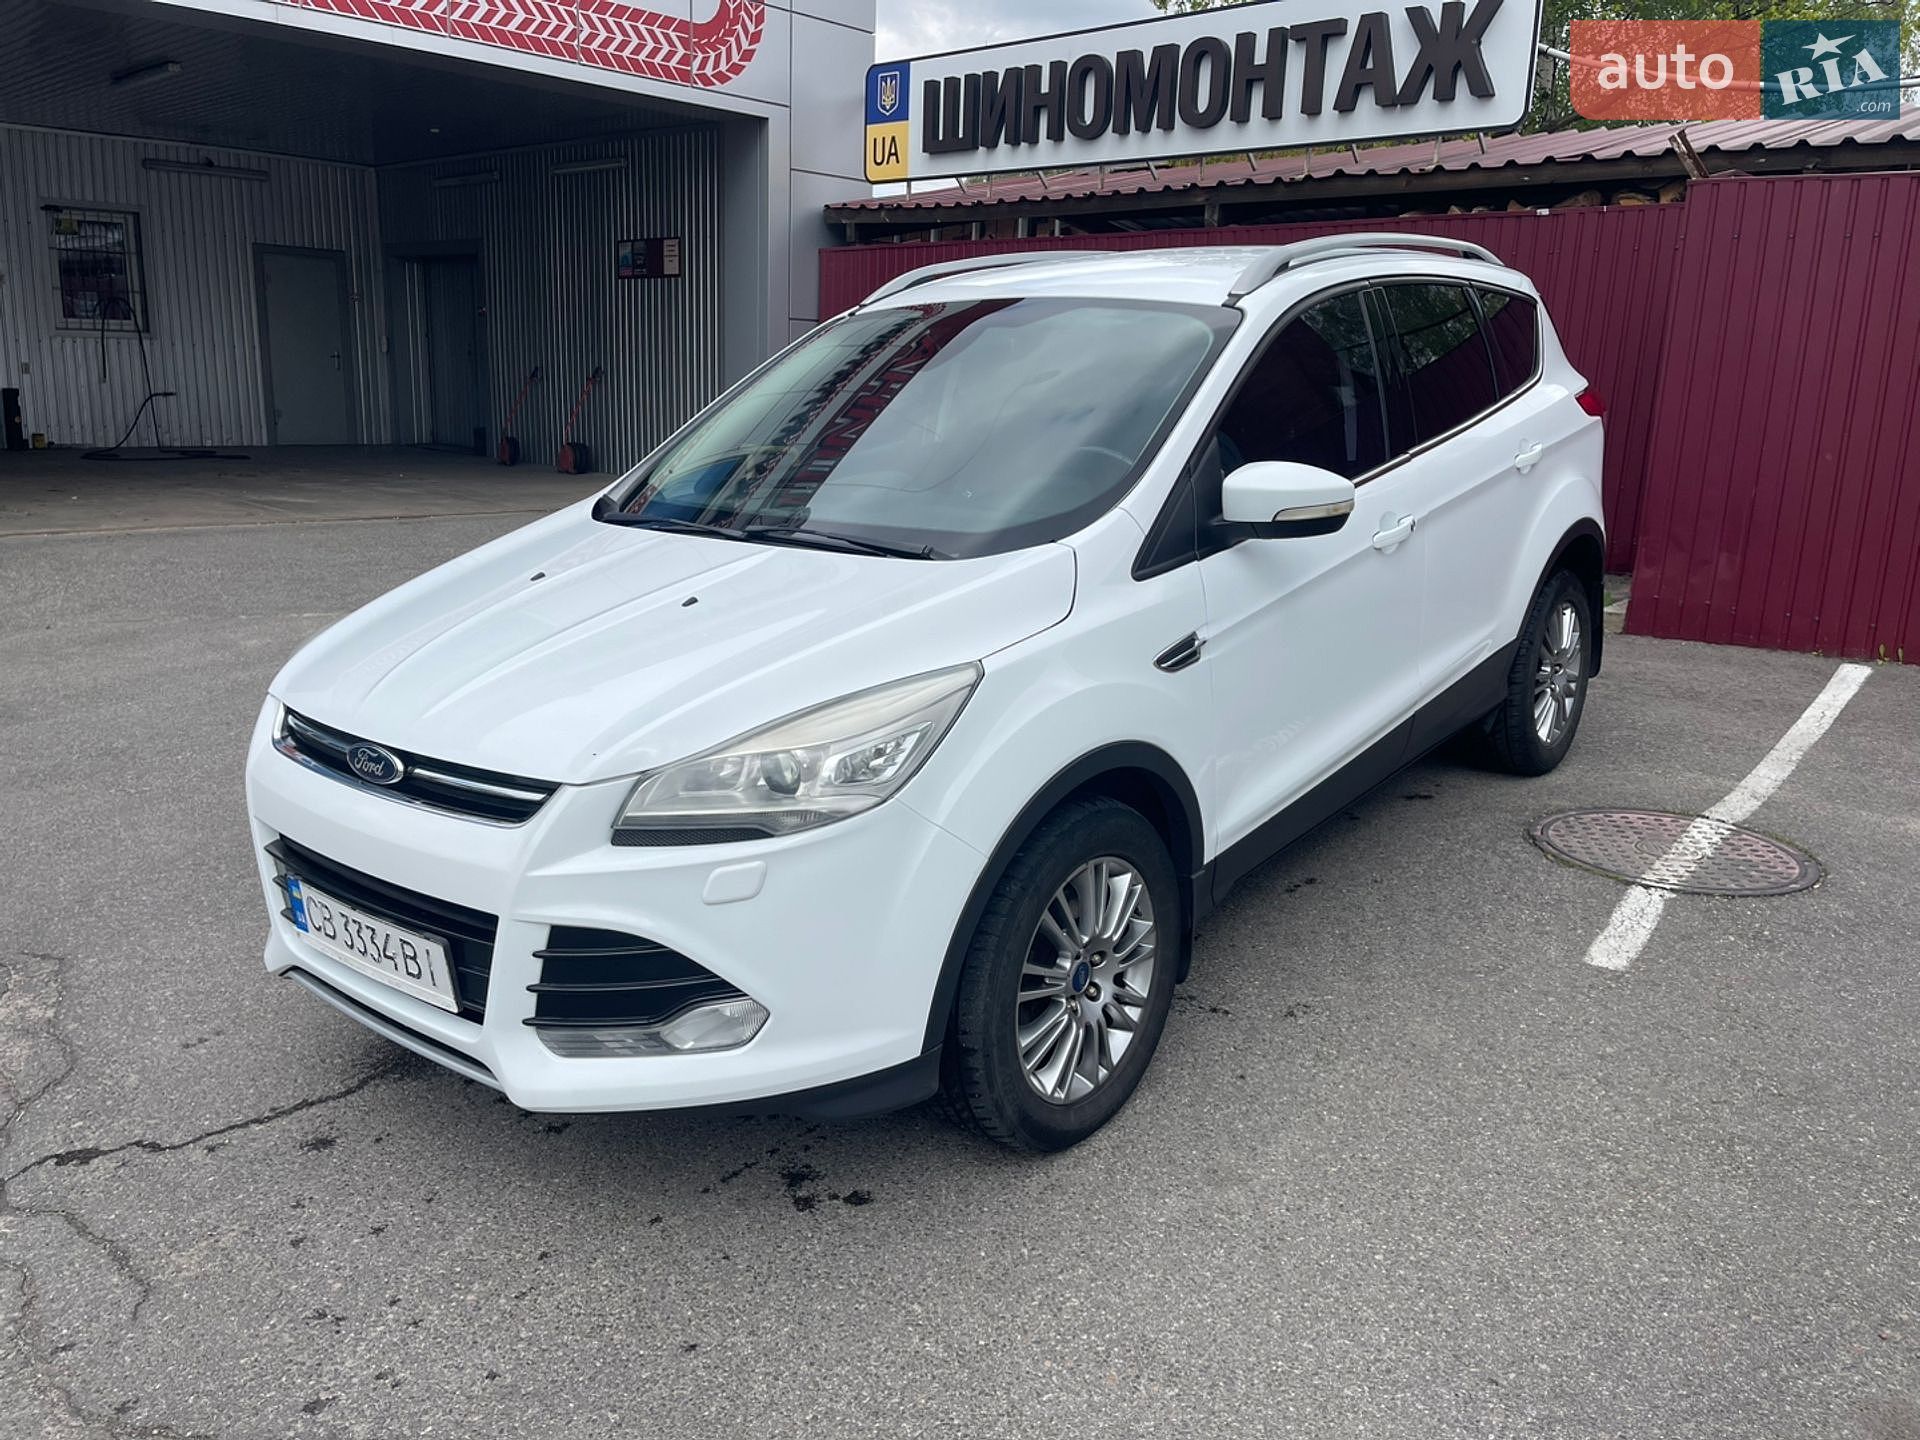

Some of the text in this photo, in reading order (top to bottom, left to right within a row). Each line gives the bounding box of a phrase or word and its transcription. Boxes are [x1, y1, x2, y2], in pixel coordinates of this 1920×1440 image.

[921, 0, 1504, 155] ШИНОМОНТАЖ
[873, 136, 900, 166] UA
[355, 747, 386, 776] Ford
